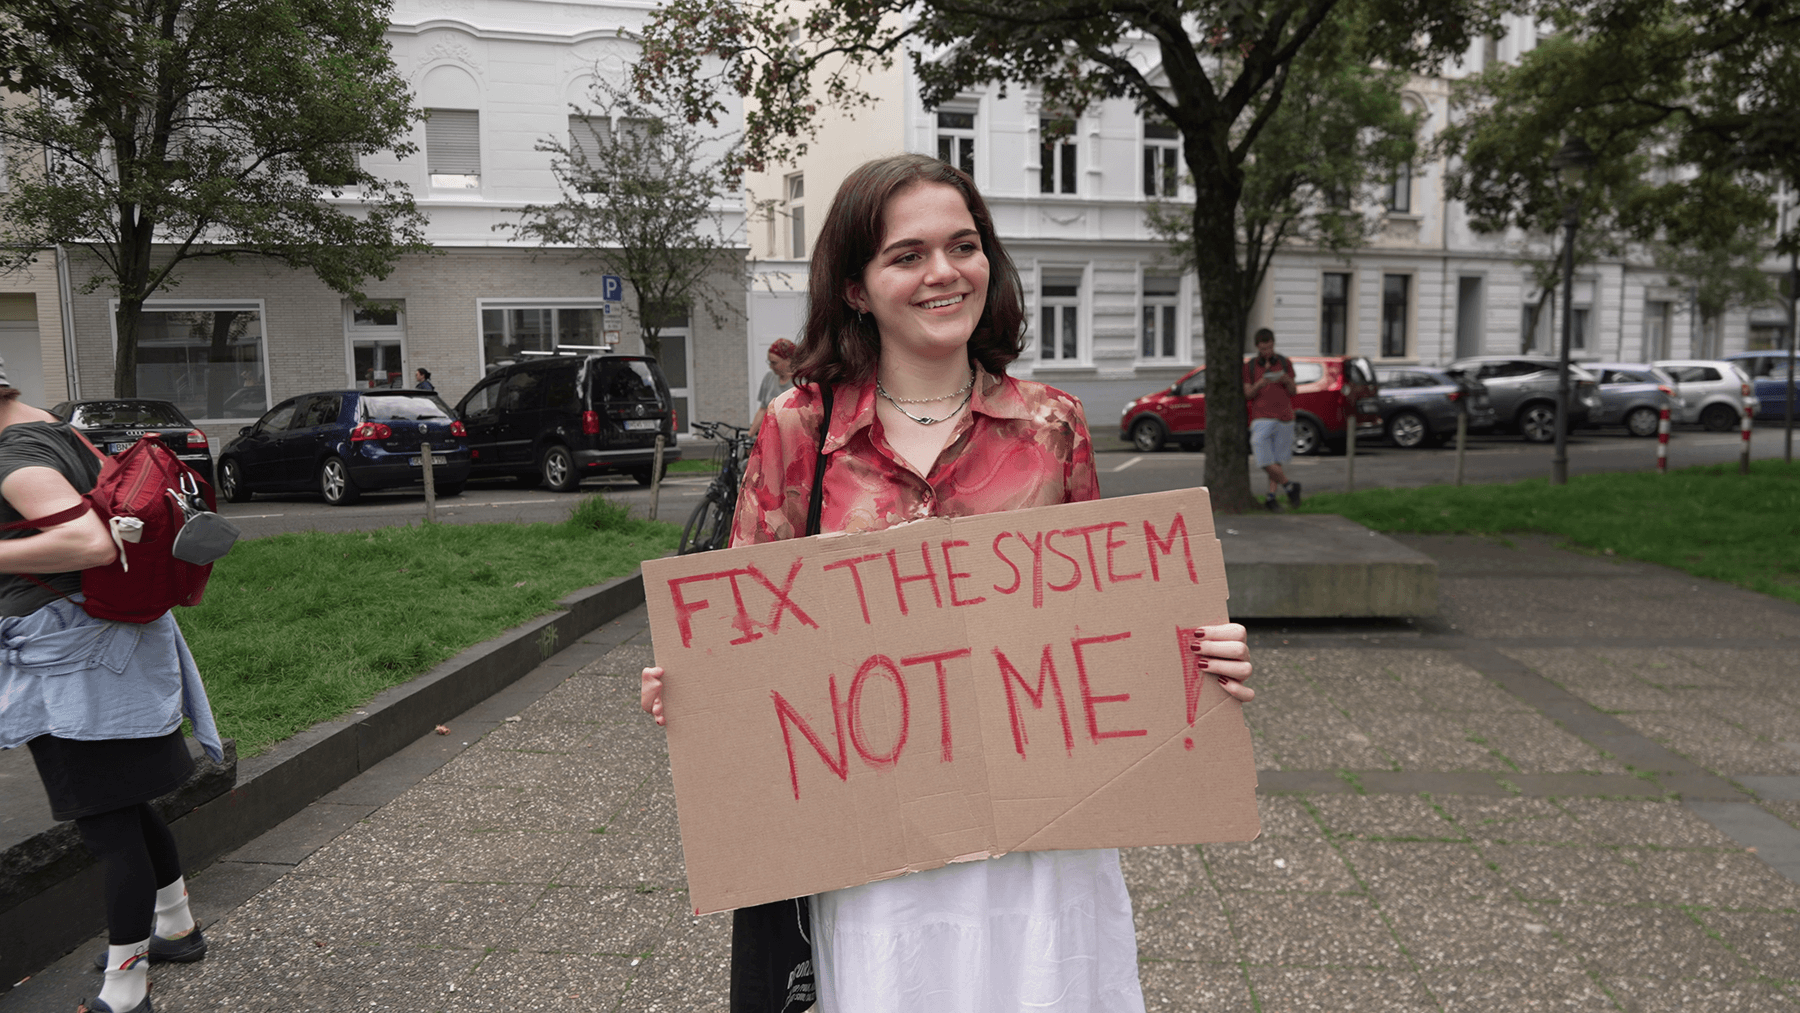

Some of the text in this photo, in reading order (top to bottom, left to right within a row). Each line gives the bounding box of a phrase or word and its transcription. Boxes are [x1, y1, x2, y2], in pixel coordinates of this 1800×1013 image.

[606, 278, 617, 298] P
[667, 512, 1199, 648] FIX THE SYSTEM
[769, 647, 972, 802] NOT
